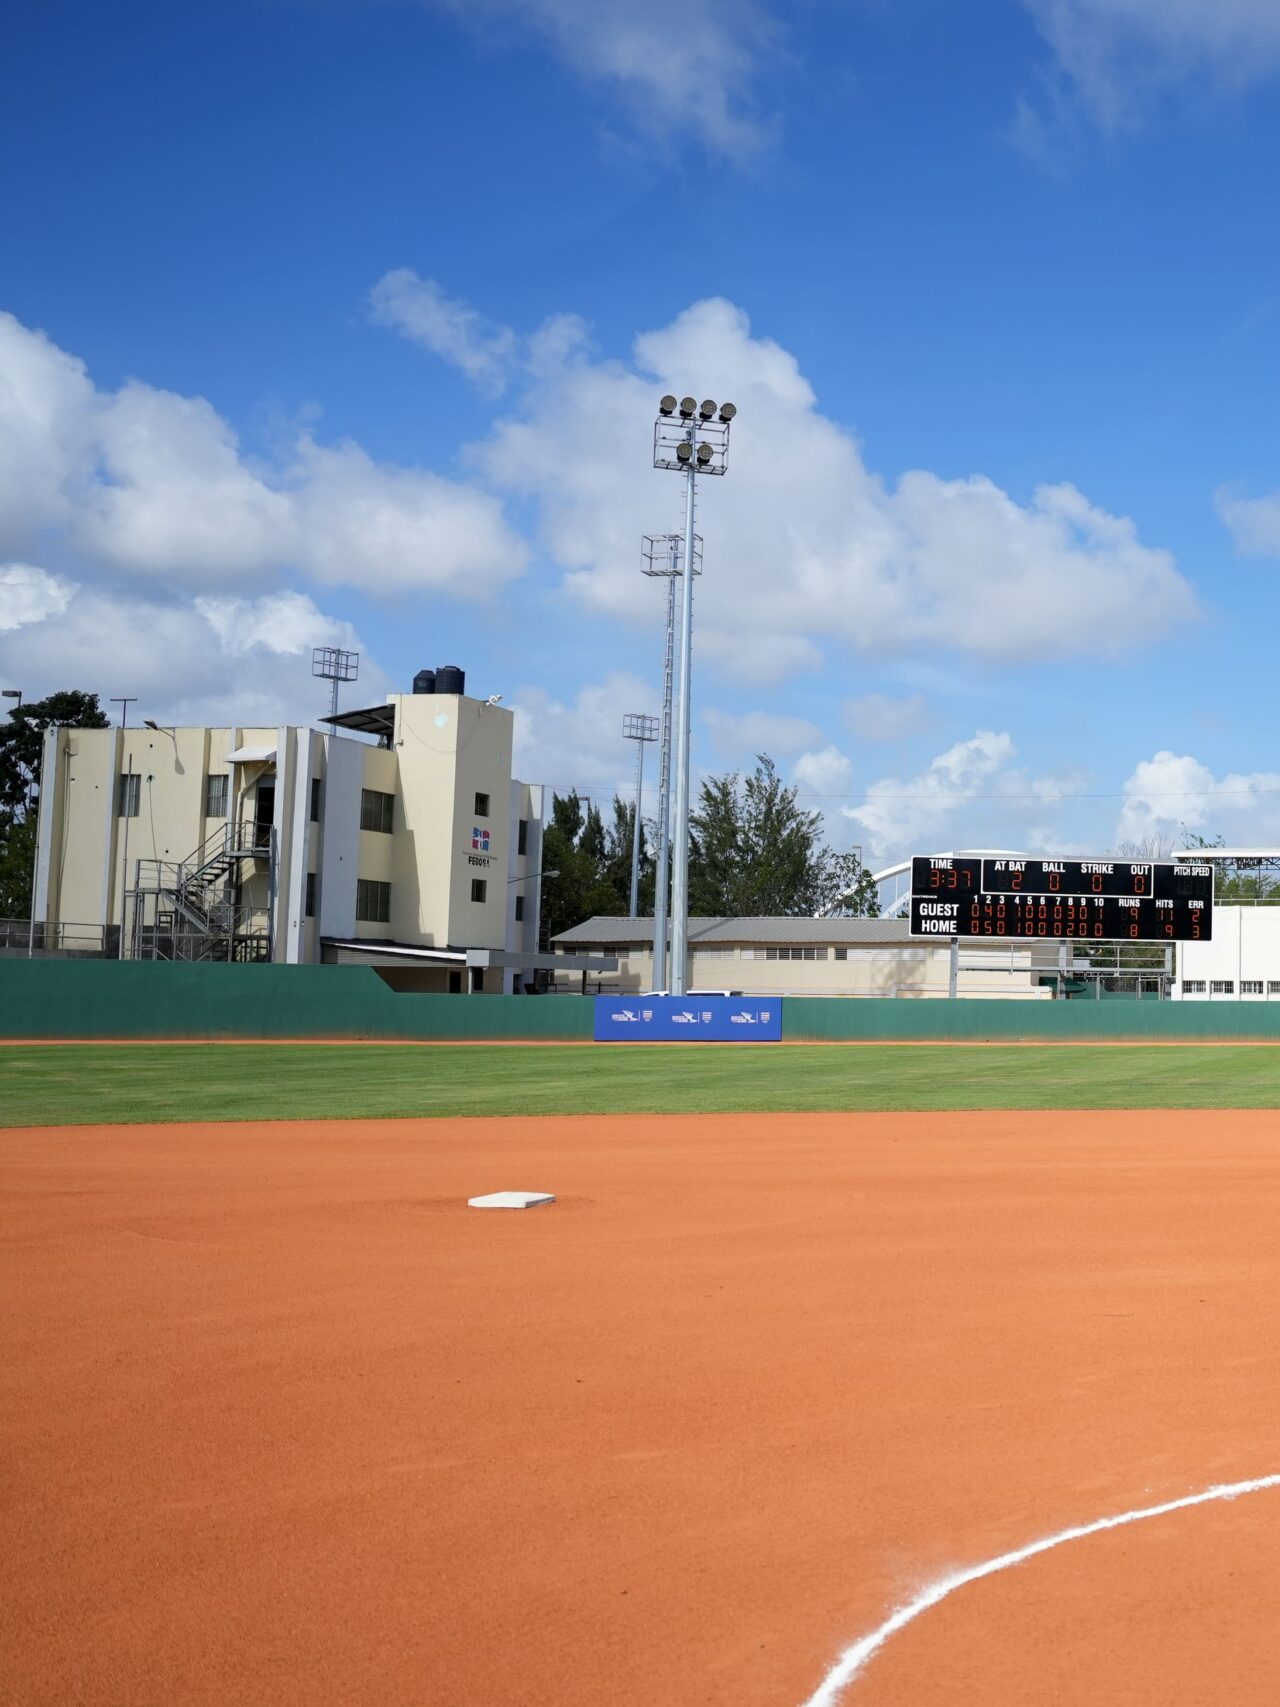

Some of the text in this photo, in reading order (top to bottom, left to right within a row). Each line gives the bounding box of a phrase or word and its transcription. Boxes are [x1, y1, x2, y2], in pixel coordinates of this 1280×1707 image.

[930, 859, 953, 869] TIME
[995, 861, 1026, 871] AT BAT
[1042, 862, 1065, 872] BALL
[1081, 864, 1113, 874] STRIKE
[1131, 865, 1149, 875] OUT
[1174, 866, 1209, 876] PITCH SPEED
[931, 870, 970, 888] 3:37
[1012, 872, 1022, 890] 2
[1050, 874, 1059, 890] 0
[1092, 875, 1102, 892] 0
[1135, 876, 1144, 892] 0
[974, 895, 978, 903] 1
[999, 896, 1005, 904] 3
[1014, 896, 1019, 904] 4
[1027, 896, 1032, 904] 5
[1040, 896, 1045, 905] 6
[1056, 897, 1061, 905] 7
[1094, 898, 1104, 906] 10
[1119, 899, 1140, 908] RUNS
[1156, 900, 1173, 908] HITS
[1189, 900, 1203, 909] ERR
[920, 903, 959, 916] GUEST
[972, 904, 979, 917] 0
[985, 905, 992, 917] 4
[998, 904, 1005, 918] 0
[1026, 905, 1033, 918] 0
[1039, 905, 1046, 918] 0
[1055, 906, 1062, 919] 0
[1068, 906, 1074, 919] 3
[1080, 906, 1087, 919] 0
[1130, 908, 1138, 920] 9
[1160, 909, 1173, 921] 11
[1192, 909, 1200, 922] 2
[922, 920, 957, 932] HOME
[971, 920, 978, 934] 0
[985, 921, 991, 934] 5
[997, 921, 1004, 934] 0
[1026, 922, 1033, 934] 0
[1038, 922, 1046, 935] 0
[1054, 922, 1061, 935] 0
[1067, 923, 1074, 936] 2
[1080, 923, 1086, 936] 0
[1095, 923, 1102, 936] 0
[1130, 924, 1138, 937] 8
[1166, 924, 1172, 936] 9
[1192, 925, 1199, 938] 3
